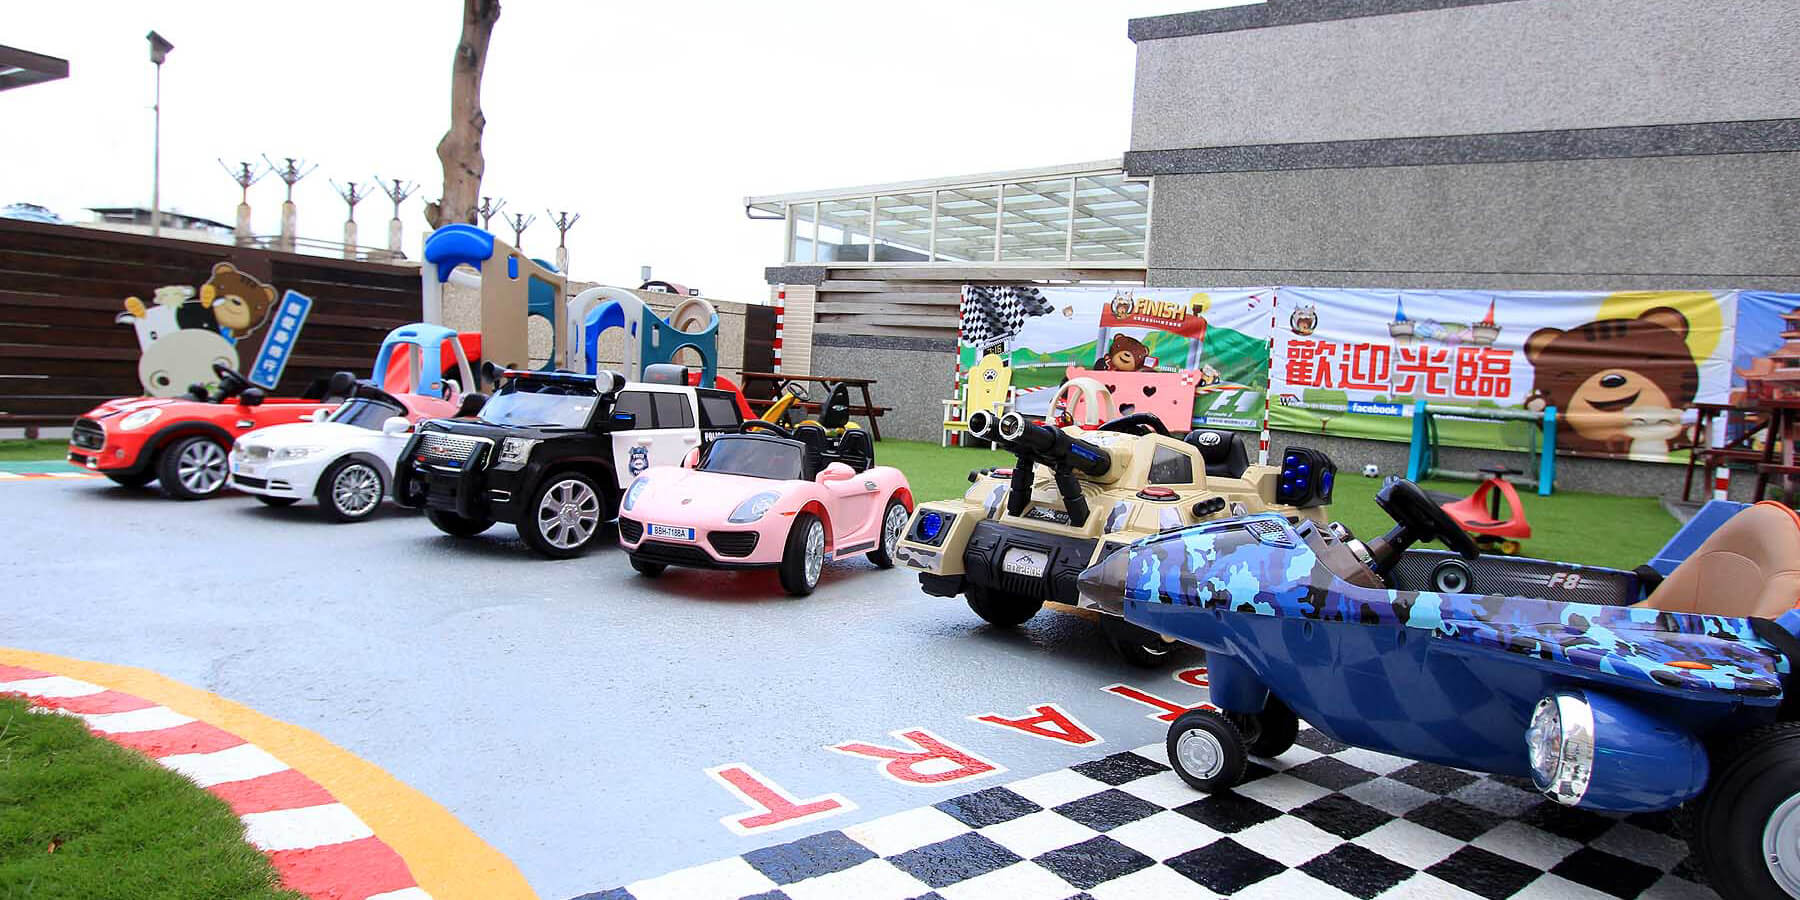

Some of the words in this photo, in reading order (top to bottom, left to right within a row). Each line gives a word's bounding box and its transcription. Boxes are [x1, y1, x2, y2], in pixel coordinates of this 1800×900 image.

[1135, 298, 1187, 320] FINISH
[1285, 339, 1515, 398] 歡迎光臨
[1352, 402, 1399, 414] facebook
[1547, 572, 1581, 589] F8
